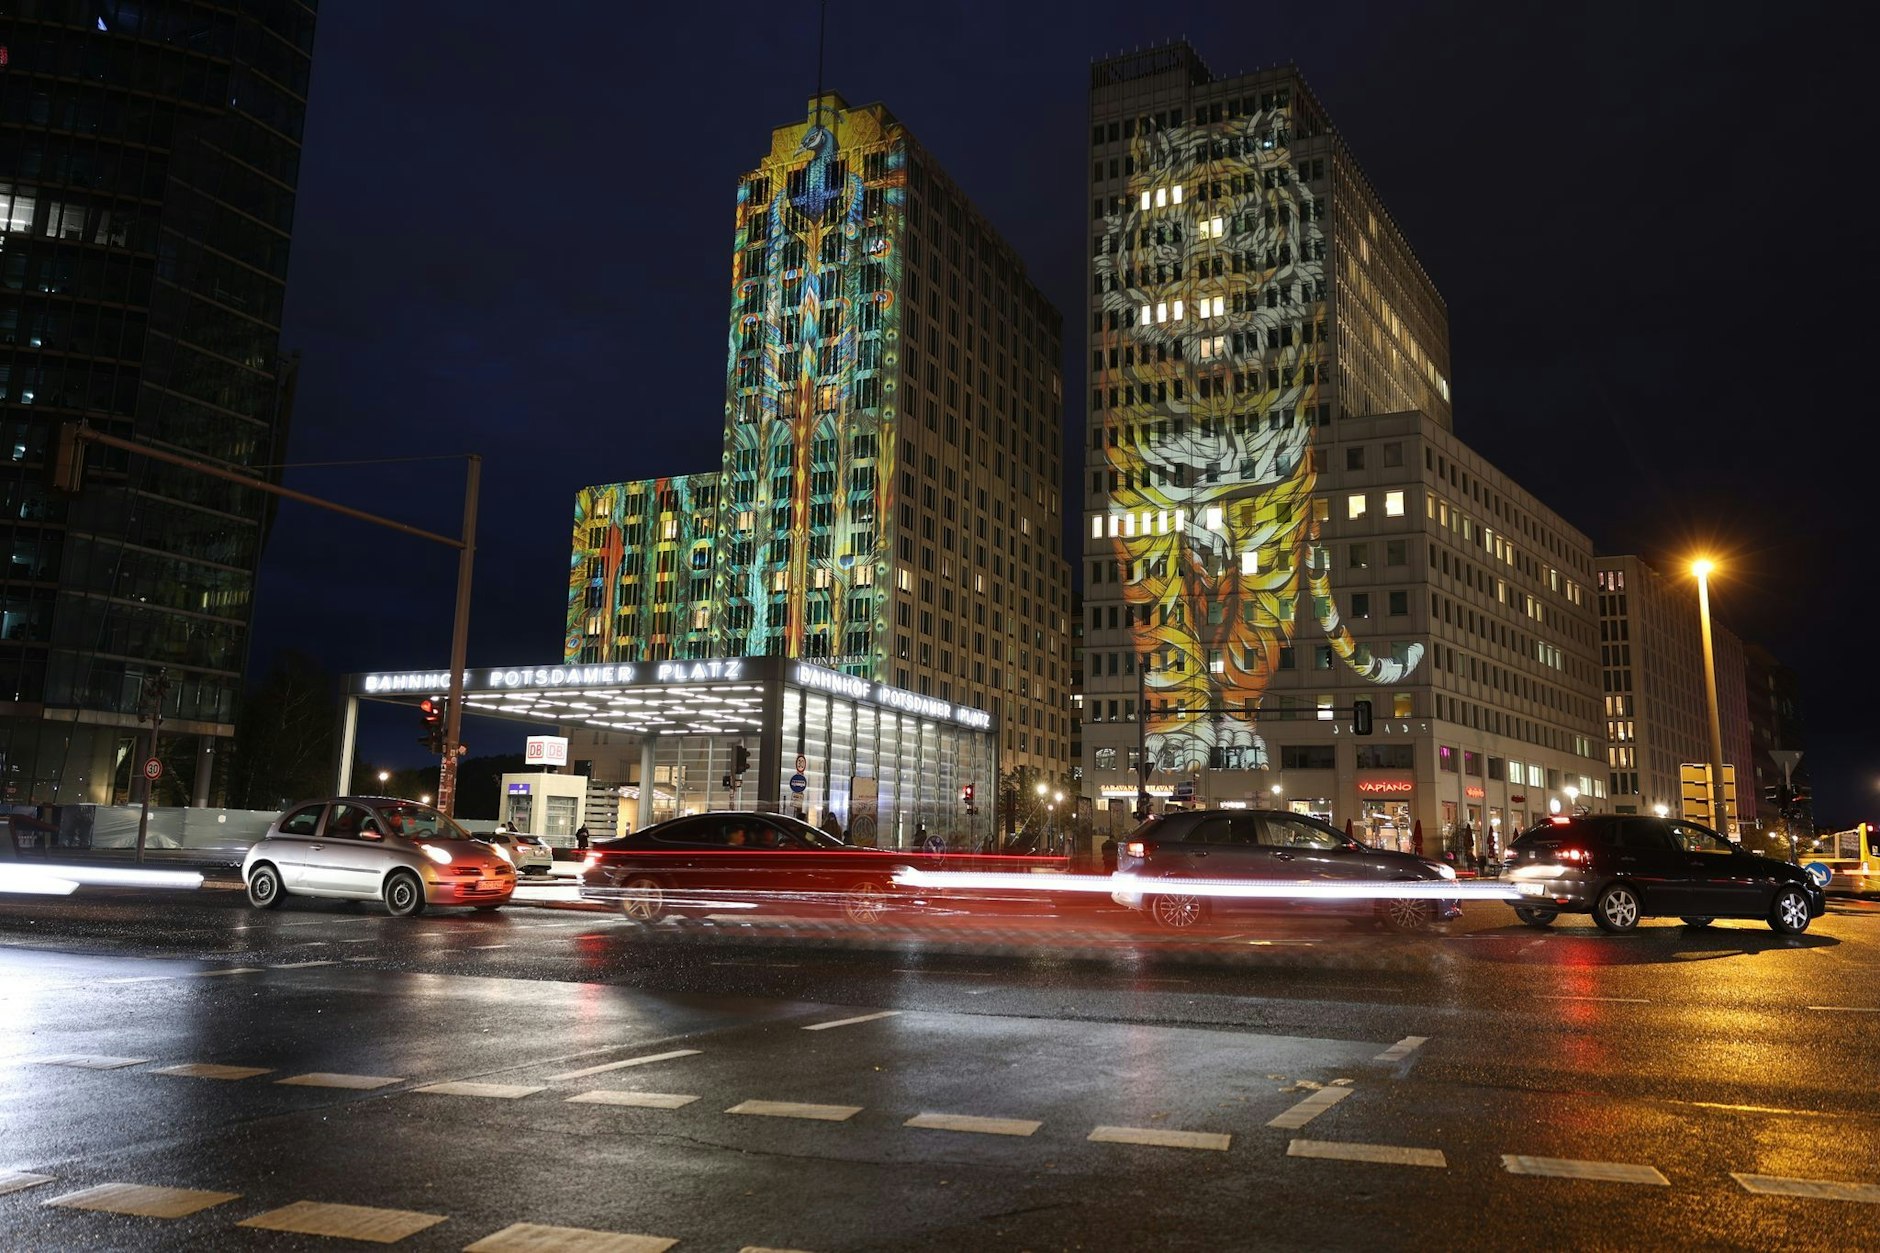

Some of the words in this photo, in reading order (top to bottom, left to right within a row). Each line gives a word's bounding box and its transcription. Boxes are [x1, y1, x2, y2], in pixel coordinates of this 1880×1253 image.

[829, 655, 866, 665] BERLIN
[490, 667, 633, 687] POTSDAMER
[658, 661, 741, 680] PLATZ
[798, 665, 871, 698] BAHNHOF
[880, 687, 951, 718] POTSDAMER
[958, 707, 990, 729] PLATZ
[529, 744, 543, 757] DB
[548, 744, 564, 757] DB
[147, 763, 159, 774] 30
